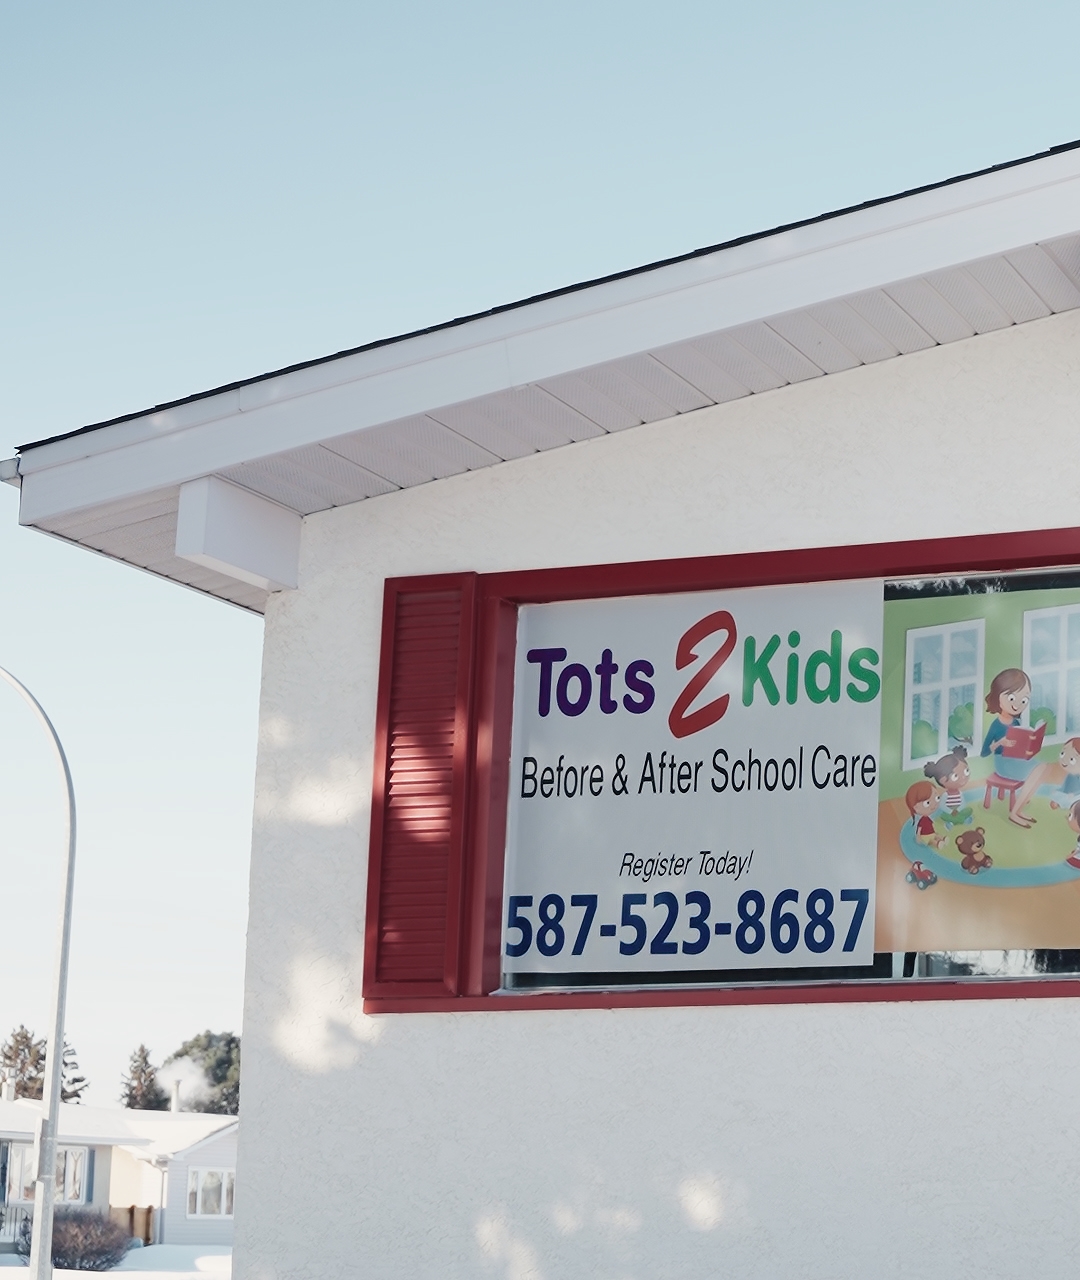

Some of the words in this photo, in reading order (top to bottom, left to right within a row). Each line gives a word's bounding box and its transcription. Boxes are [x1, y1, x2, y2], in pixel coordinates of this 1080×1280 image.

[526, 648, 655, 717] Tots
[668, 610, 737, 738] 2
[742, 630, 881, 707] Kids
[520, 755, 603, 799] Before
[611, 753, 629, 796] &
[638, 751, 704, 794] After
[711, 746, 804, 793] School
[812, 745, 877, 790] Care
[619, 852, 693, 882] Register
[699, 850, 754, 881] Today!
[505, 888, 869, 957] 587-523-8687
